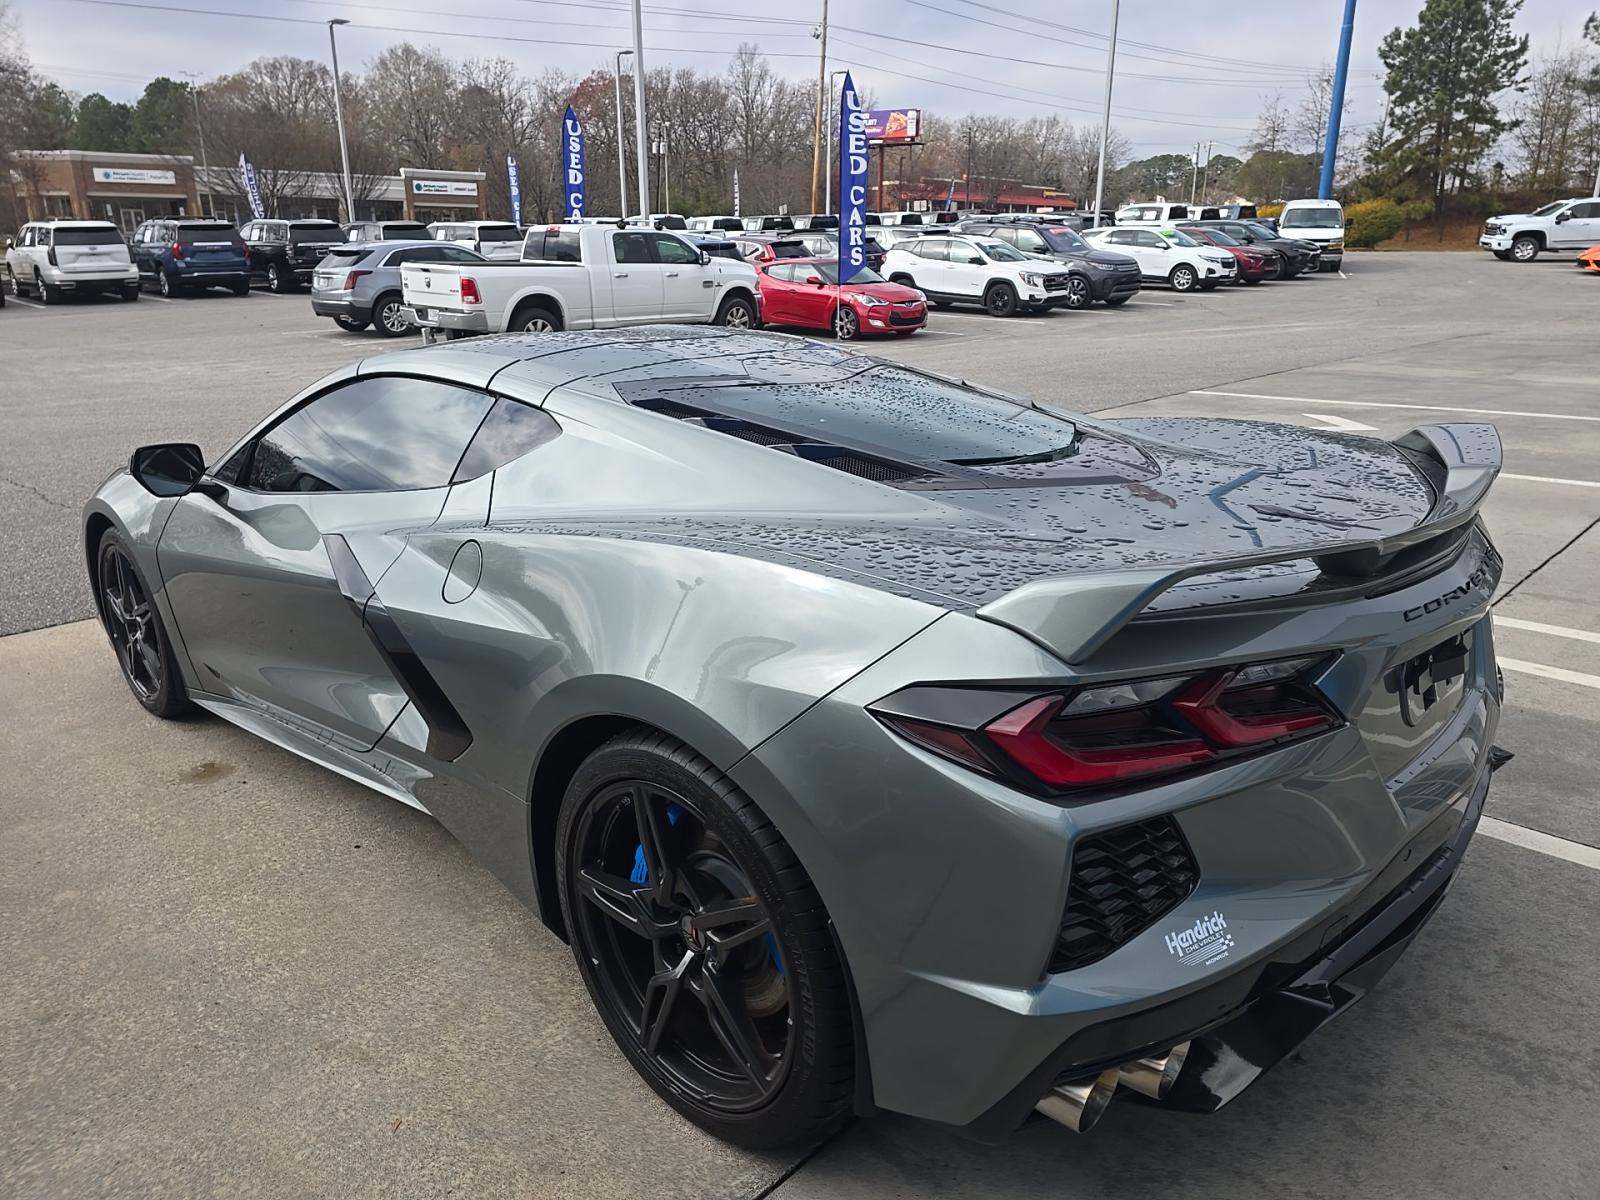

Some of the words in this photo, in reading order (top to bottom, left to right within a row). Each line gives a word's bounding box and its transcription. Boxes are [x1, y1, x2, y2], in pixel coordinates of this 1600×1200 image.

[565, 119, 583, 185] USED
[845, 90, 868, 175] USED
[849, 186, 865, 265] CARS
[1165, 911, 1227, 957] Hendrick
[1185, 931, 1225, 954] CHEVROLET
